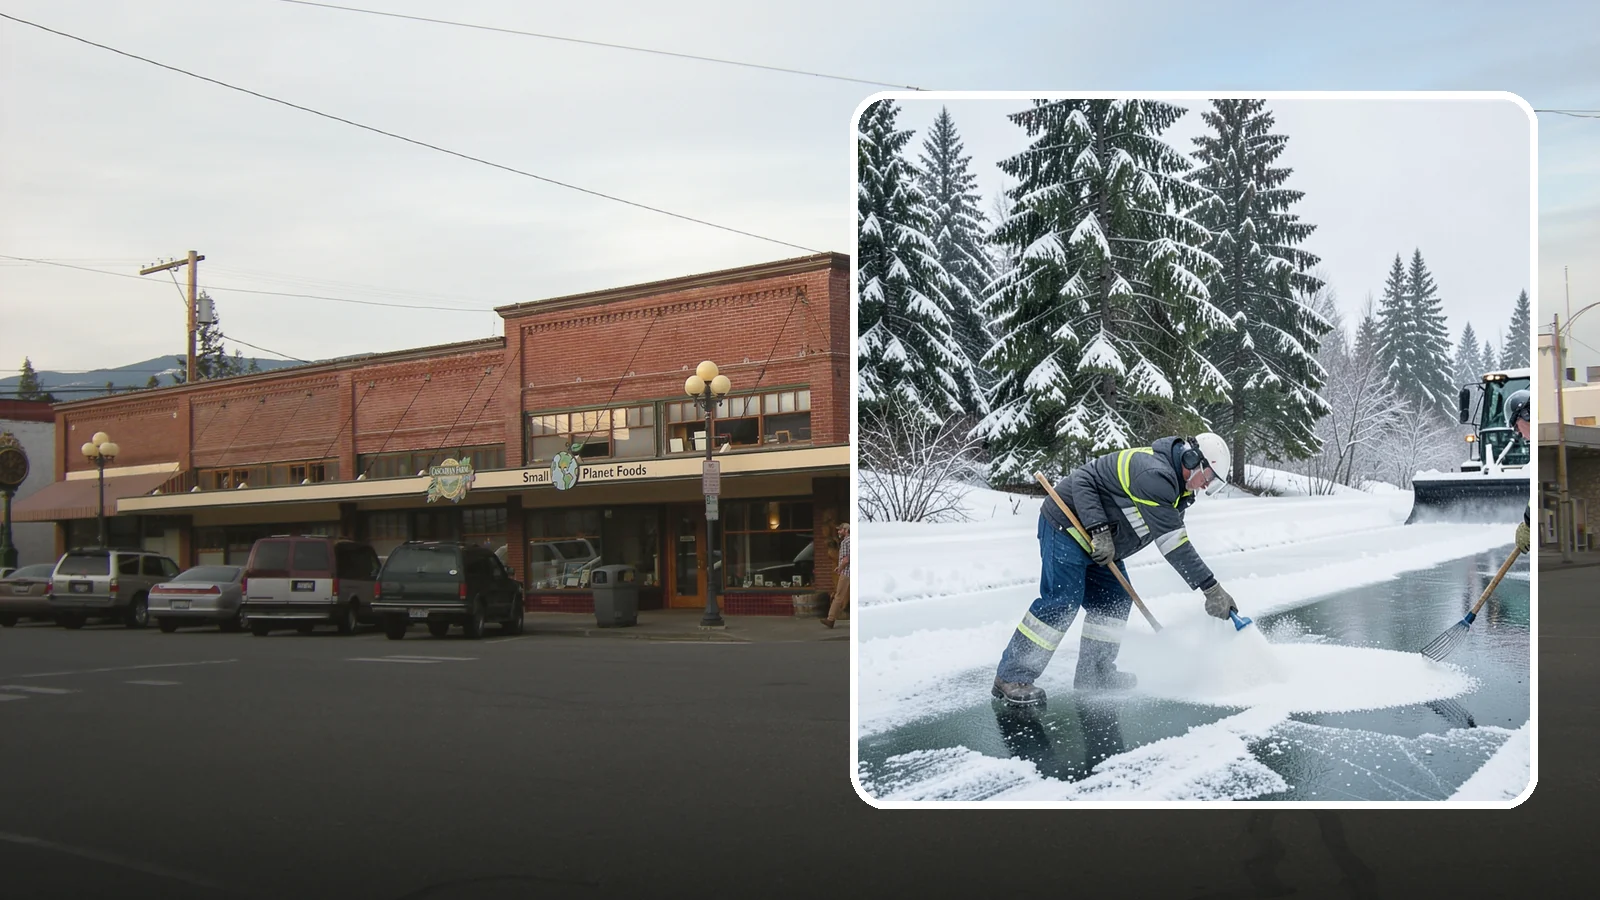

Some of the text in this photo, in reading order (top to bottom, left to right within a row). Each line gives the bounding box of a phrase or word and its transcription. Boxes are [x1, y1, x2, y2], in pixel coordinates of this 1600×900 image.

[522, 464, 647, 483] Small Planet Foods
